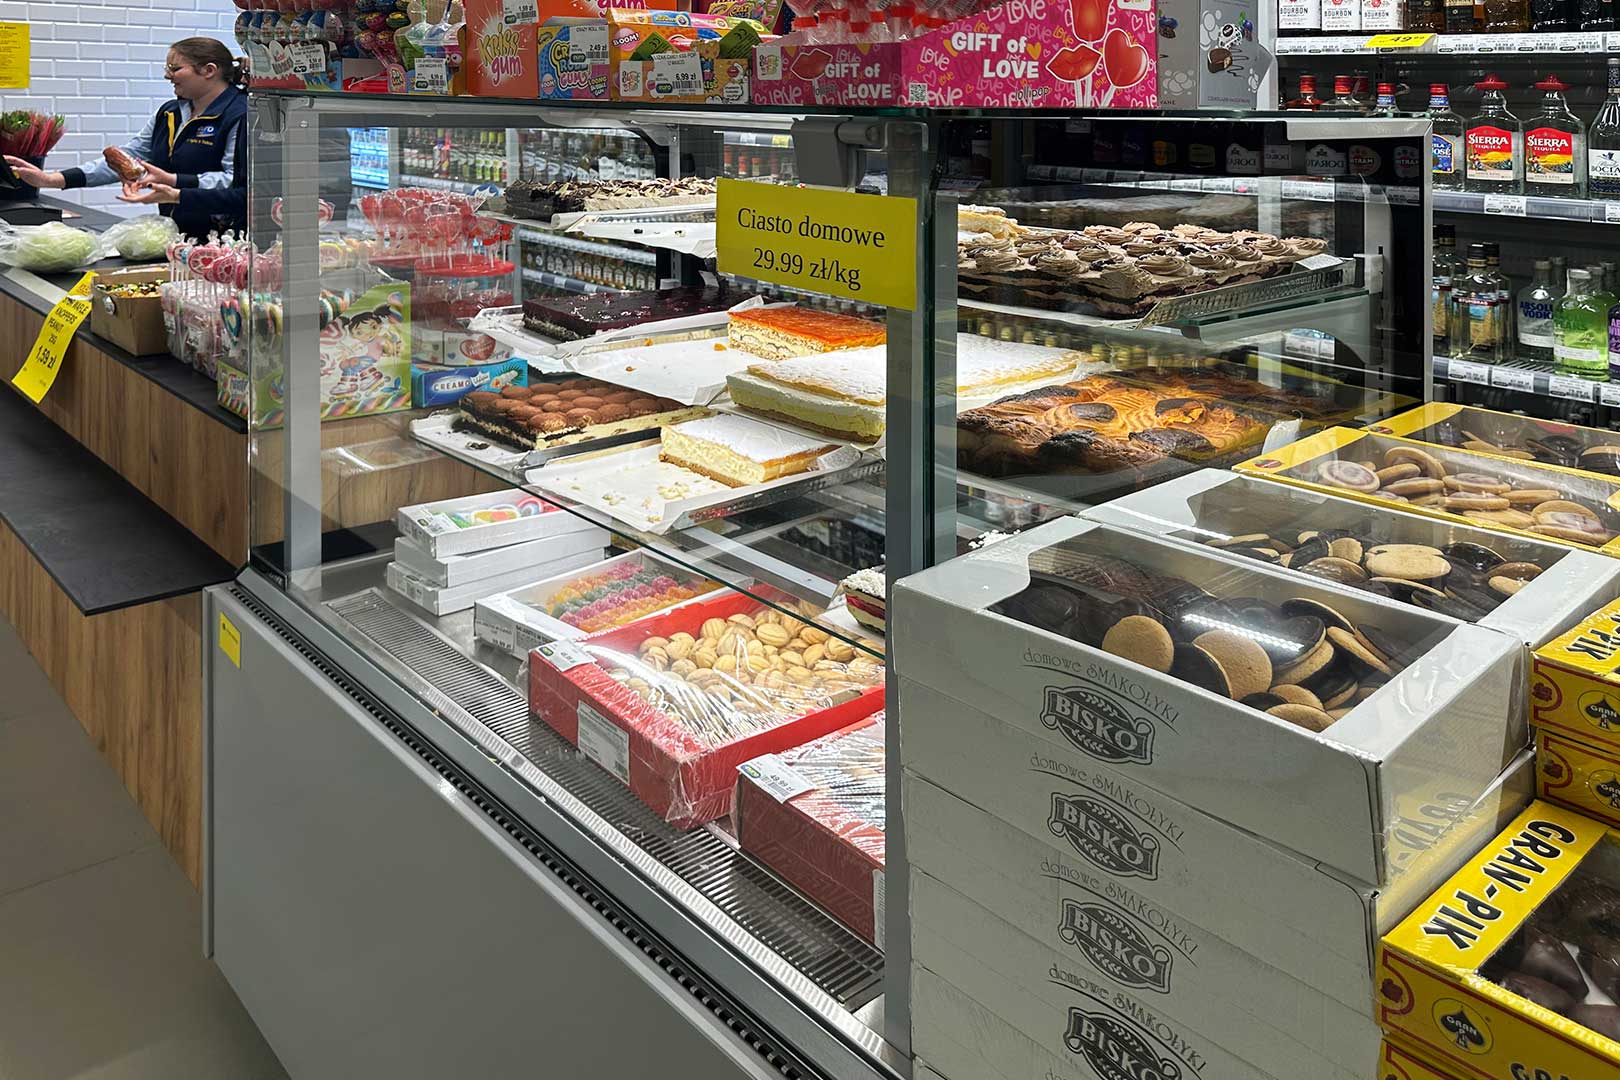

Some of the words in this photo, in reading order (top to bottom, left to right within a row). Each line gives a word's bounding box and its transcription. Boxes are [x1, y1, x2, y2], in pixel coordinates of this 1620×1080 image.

[1280, 7, 1309, 15] BOURBON
[1364, 10, 1389, 18] BOURBON
[612, 32, 640, 47] BOOM!
[951, 32, 1002, 53] GIFT
[1007, 36, 1028, 54] of
[491, 55, 523, 86] gum
[824, 62, 860, 78] GIFT
[864, 62, 881, 78] of
[983, 59, 1040, 79] LOVE
[848, 83, 893, 99] LOVE
[1014, 86, 1050, 101] lollipop
[1468, 133, 1509, 145] SIERRA
[1527, 135, 1569, 147] SIERRA
[738, 206, 793, 234] Ciasto
[798, 215, 886, 248] domowe
[753, 247, 804, 275] 29.99
[809, 257, 862, 291] zł/kg
[434, 380, 471, 392] CREAMO
[1023, 647, 1081, 673] domowe
[1055, 694, 1138, 751] BISKO
[1030, 752, 1088, 782] domowe
[1063, 802, 1144, 865] BISKO
[1040, 857, 1100, 890] domowe
[1422, 820, 1576, 950] GRAN-PIK
[1073, 906, 1156, 978] BISKO
[1049, 963, 1110, 999] domowe
[1446, 1015, 1478, 1036] GRAN
